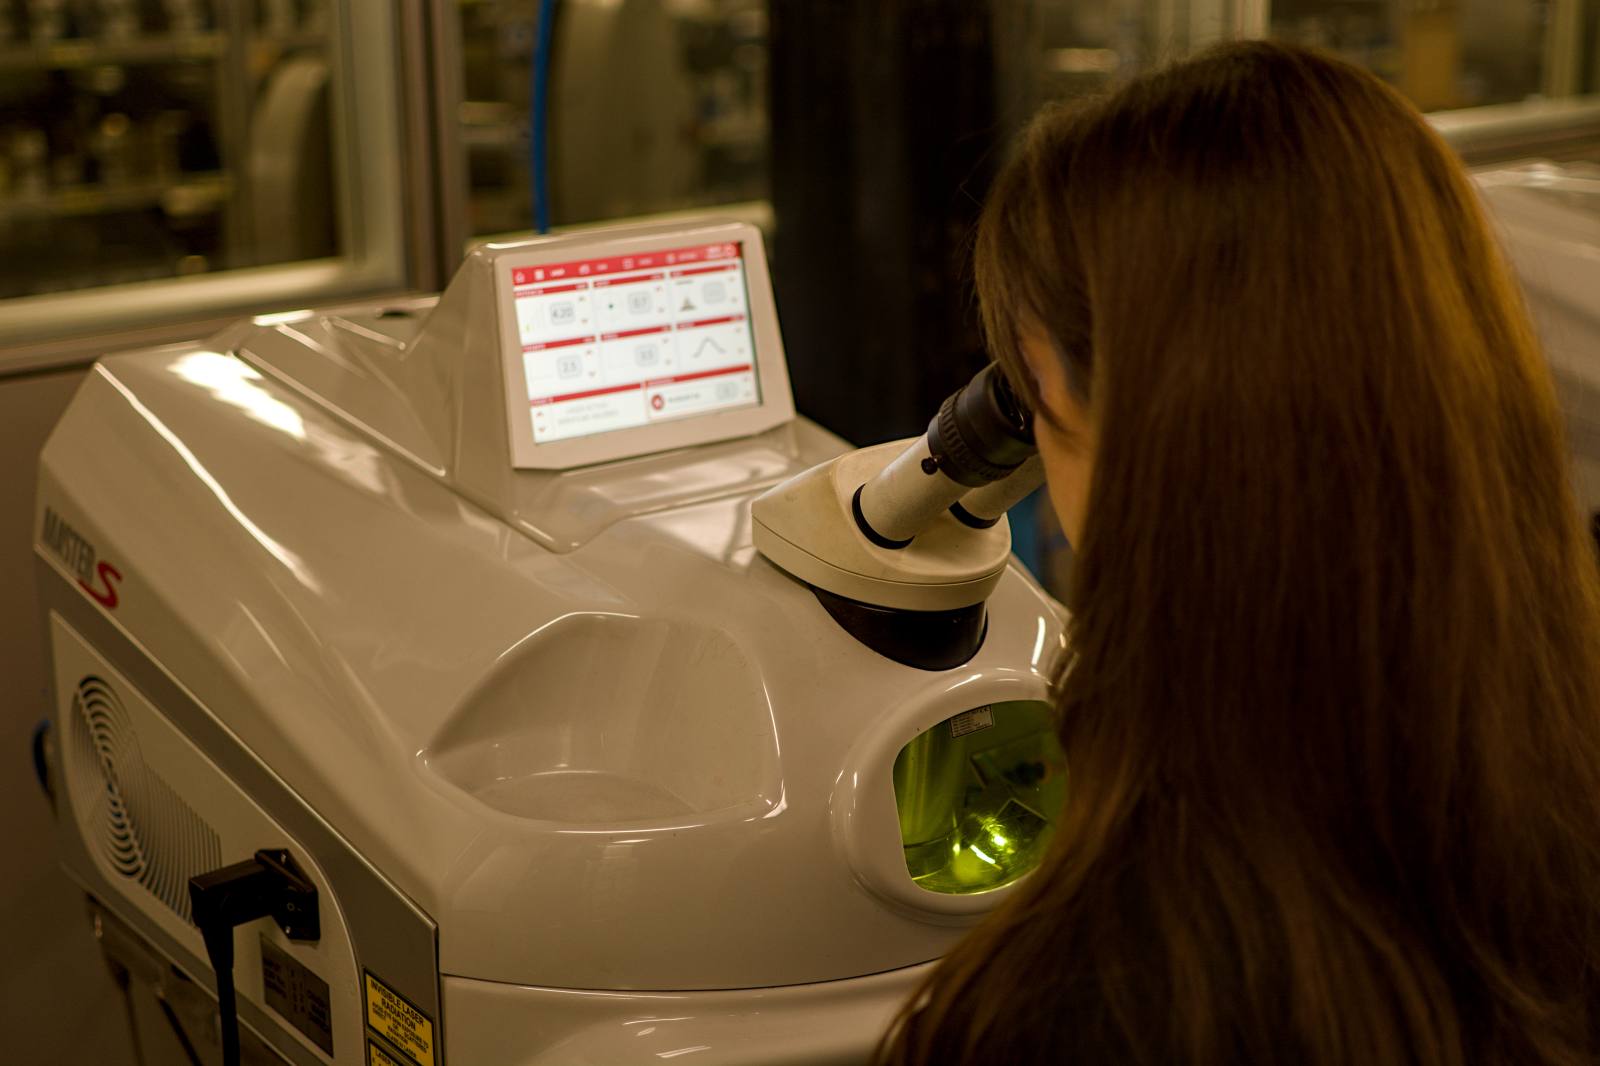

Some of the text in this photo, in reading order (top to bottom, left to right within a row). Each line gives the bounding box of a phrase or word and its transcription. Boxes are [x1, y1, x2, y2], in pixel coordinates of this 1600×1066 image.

[78, 560, 123, 609] S
[371, 979, 424, 1026] INVISIBLE LASER
[382, 997, 416, 1030] RADIATION
[388, 1025, 408, 1044] RADIATION
